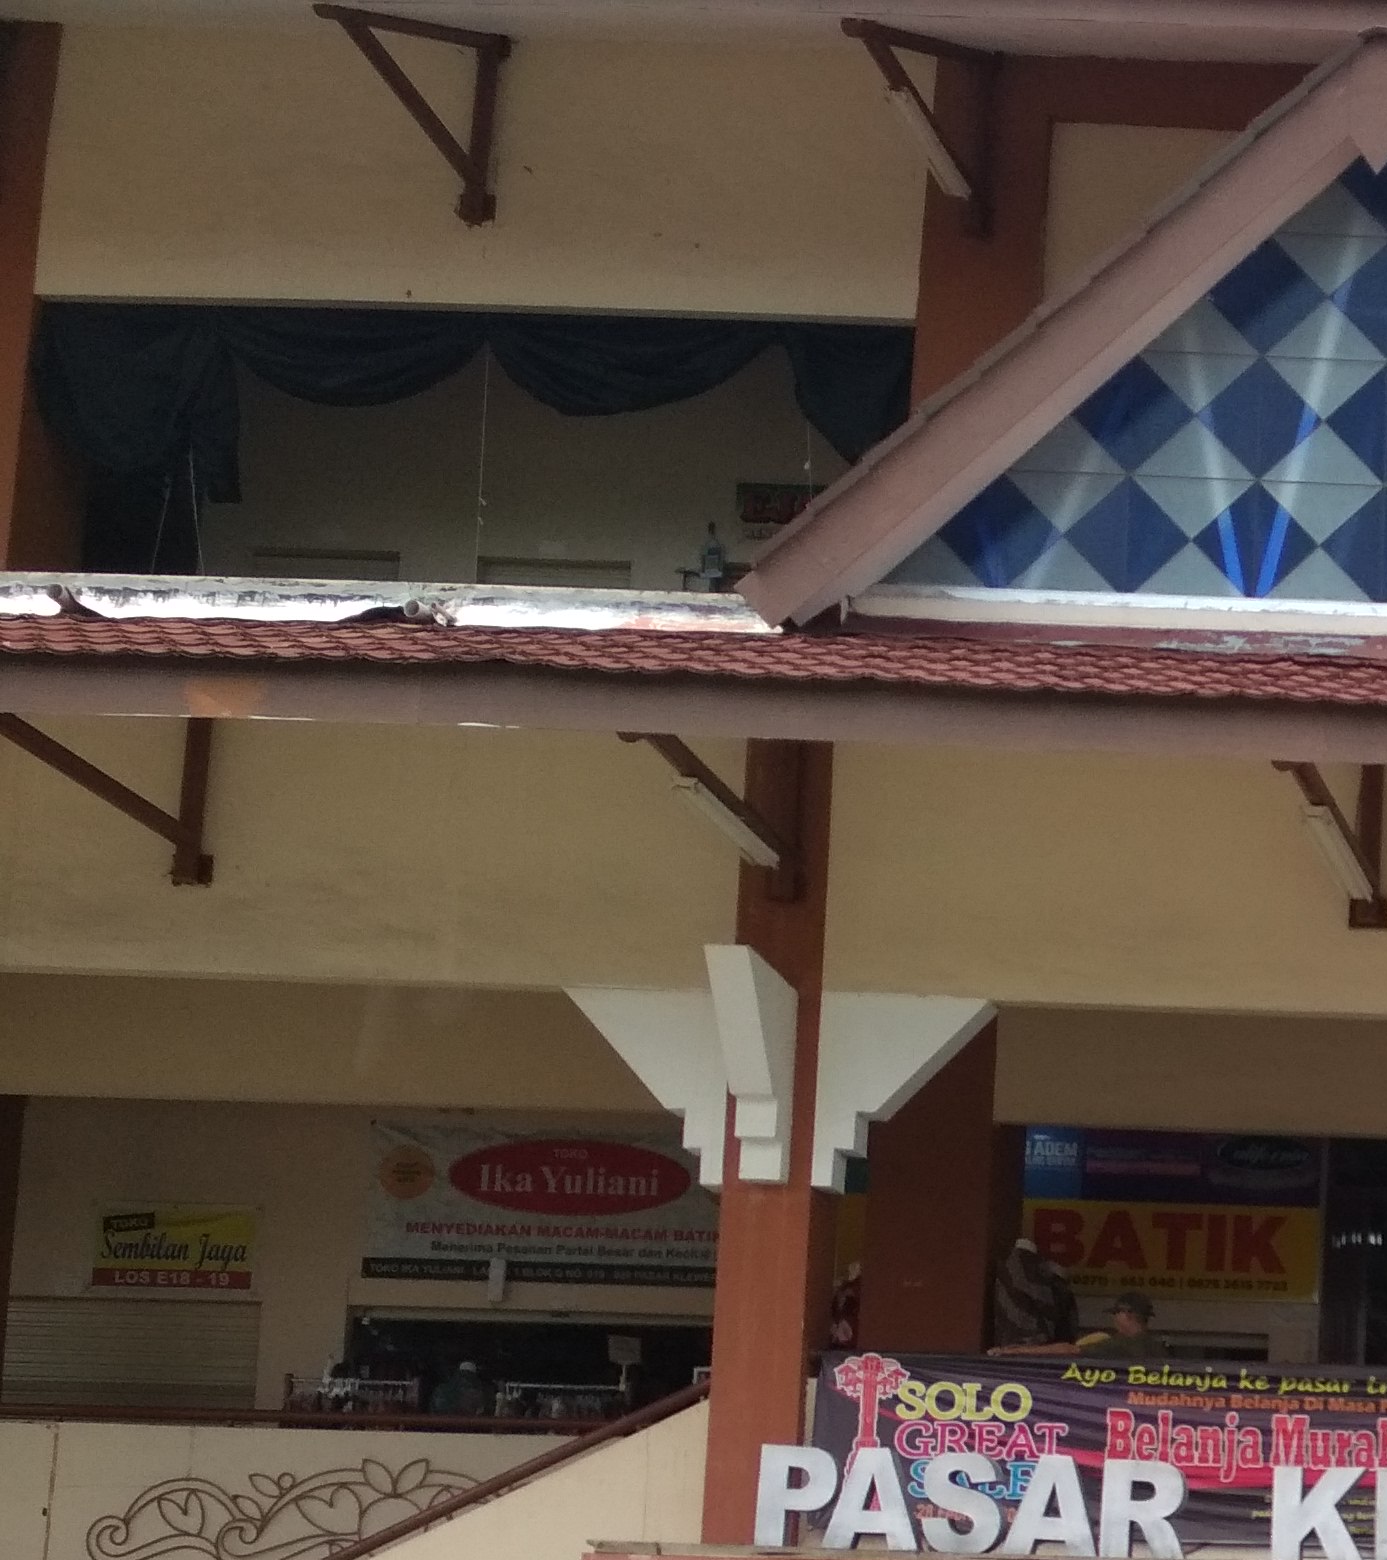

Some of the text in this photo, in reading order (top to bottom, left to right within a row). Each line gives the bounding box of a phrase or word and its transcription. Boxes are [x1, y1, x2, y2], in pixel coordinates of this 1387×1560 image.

[553, 1148, 589, 1159] TOKO
[479, 1163, 660, 1196] Ika Yuliani
[110, 1217, 149, 1229] TOKO
[405, 1221, 531, 1237] MENYEDIAKAN
[537, 1226, 668, 1241] MACAM-MACAM
[101, 1230, 248, 1271] Sembilan Jaga
[1033, 1208, 1288, 1275] BATIK
[114, 1271, 150, 1284] LOS
[157, 1271, 191, 1285] E18
[208, 1272, 230, 1286] 19
[1060, 1362, 1117, 1388] Ayo
[1127, 1364, 1229, 1392] Belanja
[1237, 1368, 1271, 1391] ke
[895, 1380, 1033, 1422] SOLO
[1127, 1391, 1226, 1411] Mudahnya
[1229, 1393, 1300, 1414] Belanja
[894, 1420, 1069, 1461] GREAT
[1105, 1407, 1264, 1483] Belanja
